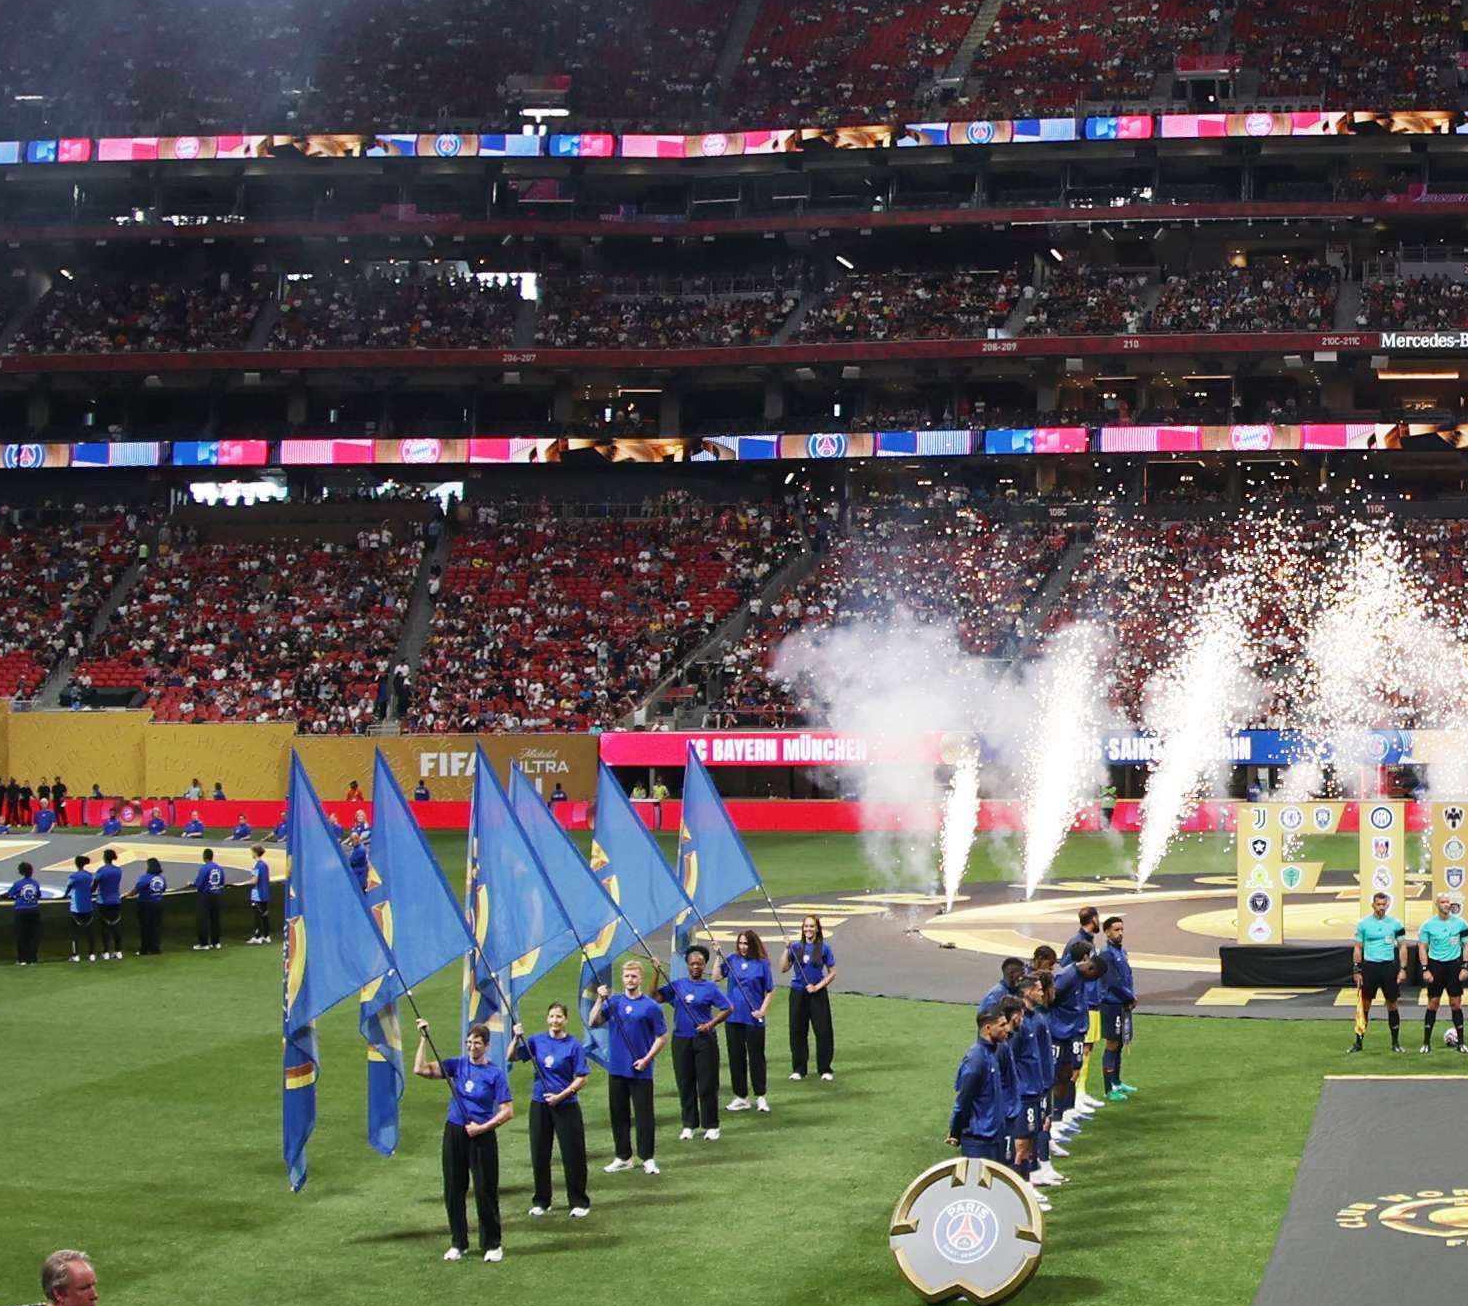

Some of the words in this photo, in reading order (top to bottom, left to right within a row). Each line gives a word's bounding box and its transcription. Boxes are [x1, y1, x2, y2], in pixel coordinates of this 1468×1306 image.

[1123, 340, 1140, 349] 210
[712, 739, 777, 762] BAYERN
[782, 735, 868, 762] MÜNCHEN
[1027, 1107, 1035, 1123] 8
[947, 1204, 990, 1220] PARIS
